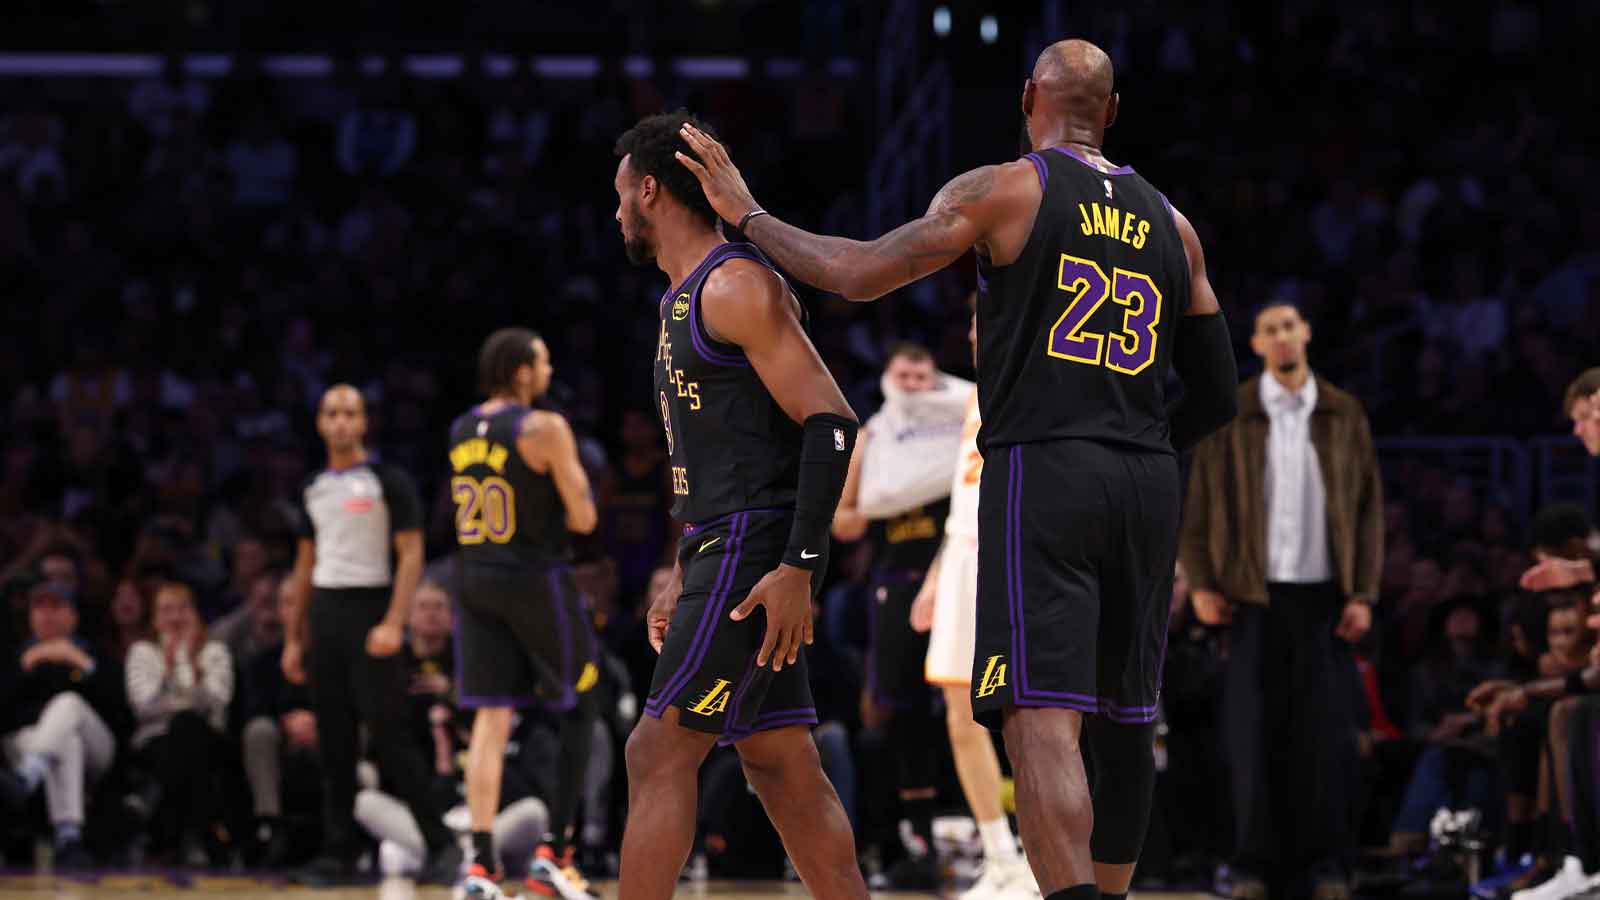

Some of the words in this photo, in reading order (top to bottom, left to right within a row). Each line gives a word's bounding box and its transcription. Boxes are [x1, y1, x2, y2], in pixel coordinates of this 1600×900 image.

[1079, 203, 1150, 249] JAMES
[1048, 253, 1162, 375] 23
[451, 476, 516, 544] 20
[686, 679, 731, 716] LA
[976, 655, 1007, 698] LA
